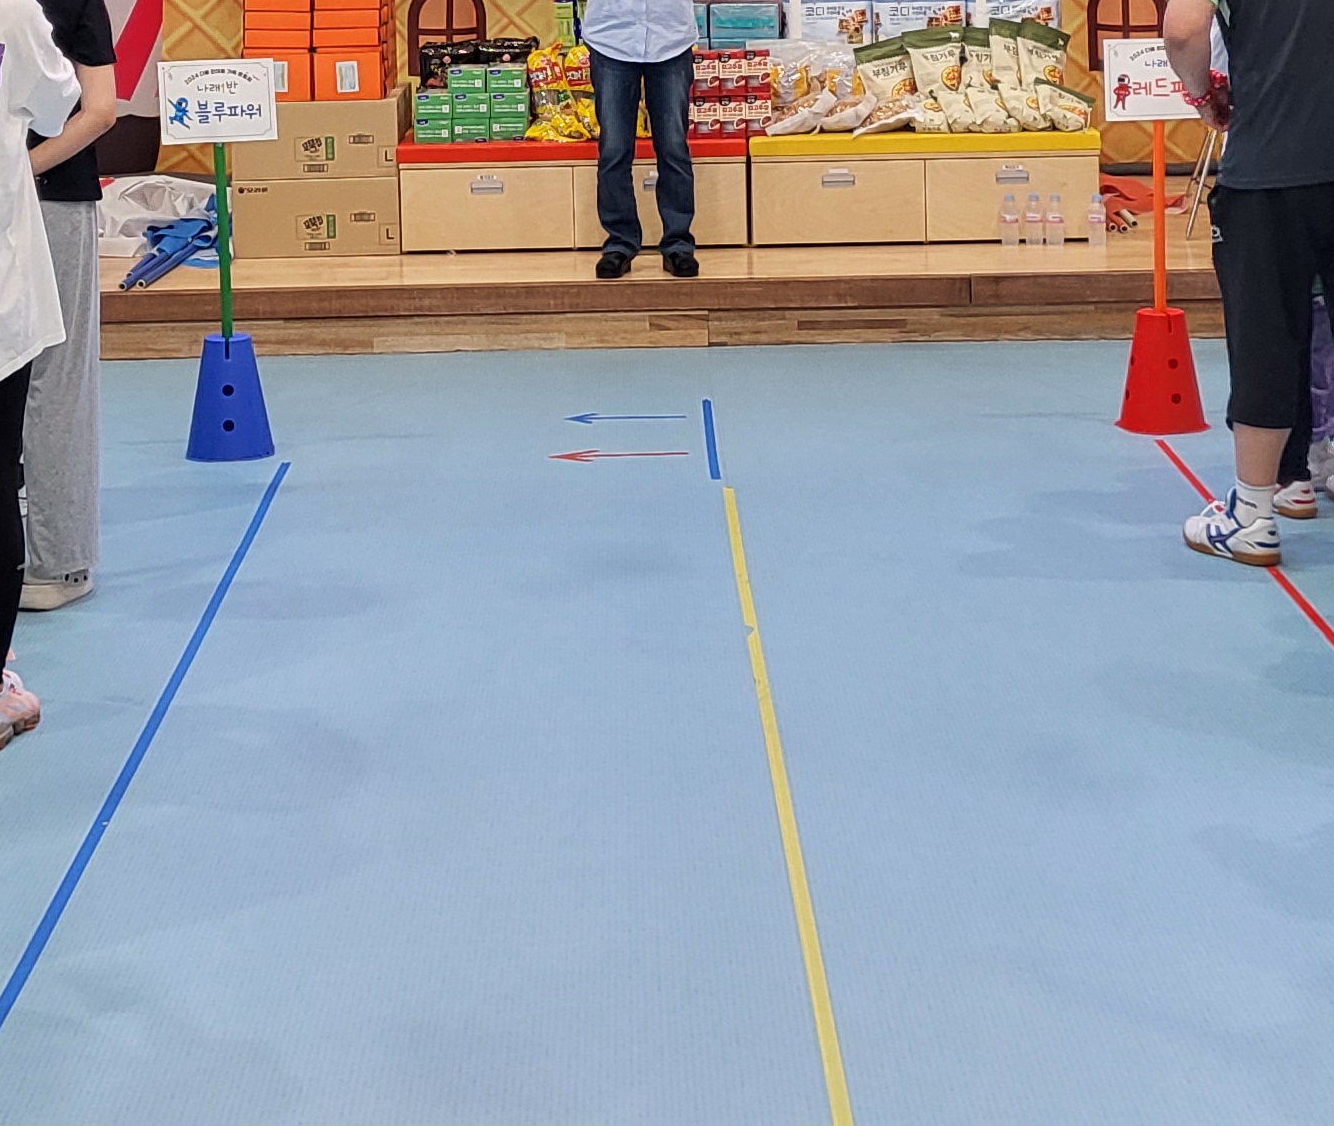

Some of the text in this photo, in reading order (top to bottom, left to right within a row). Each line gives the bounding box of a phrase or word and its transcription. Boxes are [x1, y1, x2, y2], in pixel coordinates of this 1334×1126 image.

[194, 100, 262, 124] 블루파워
[384, 149, 394, 162] L
[385, 228, 395, 240] L
